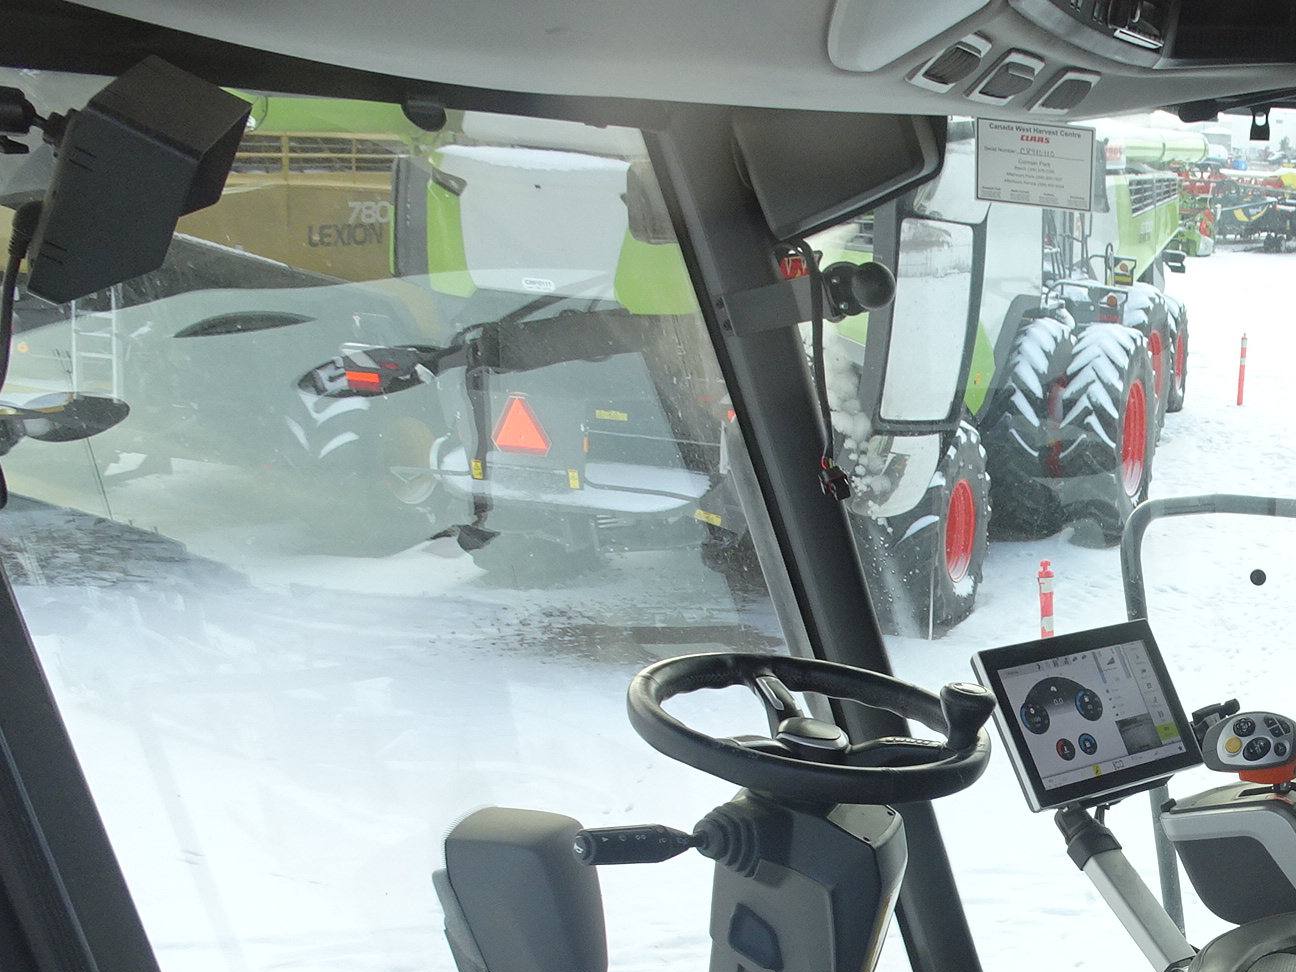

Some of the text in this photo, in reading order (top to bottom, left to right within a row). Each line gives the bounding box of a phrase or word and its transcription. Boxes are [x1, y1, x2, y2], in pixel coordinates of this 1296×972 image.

[989, 122, 1081, 138] Canada West Harvest Centre
[1020, 134, 1051, 144] CLAAS
[347, 201, 391, 224] 780
[308, 224, 384, 247] LEXION
